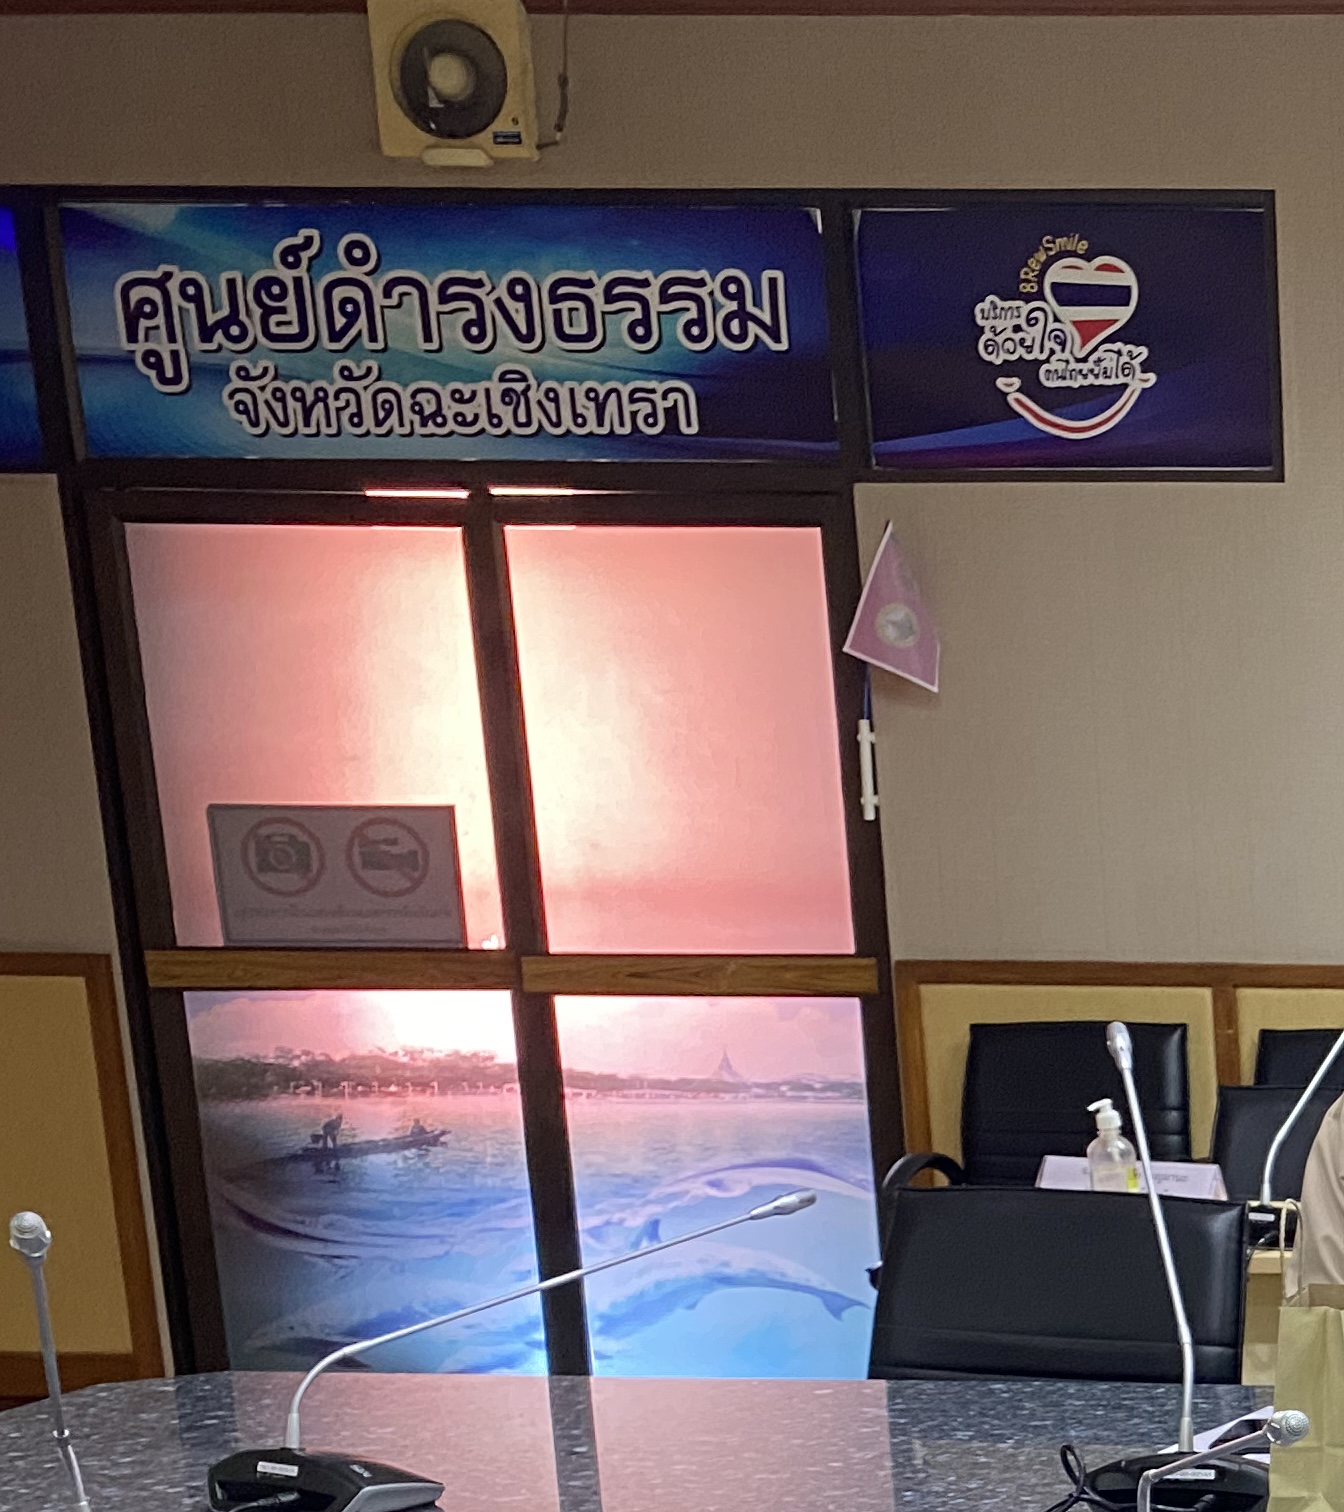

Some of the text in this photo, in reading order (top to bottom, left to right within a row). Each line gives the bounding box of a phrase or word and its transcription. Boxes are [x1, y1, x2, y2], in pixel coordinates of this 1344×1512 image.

[117, 231, 788, 391] ศูนย์ดำรงธรรม
[225, 362, 699, 436] จังหวัดฉะเชิงเทรา
